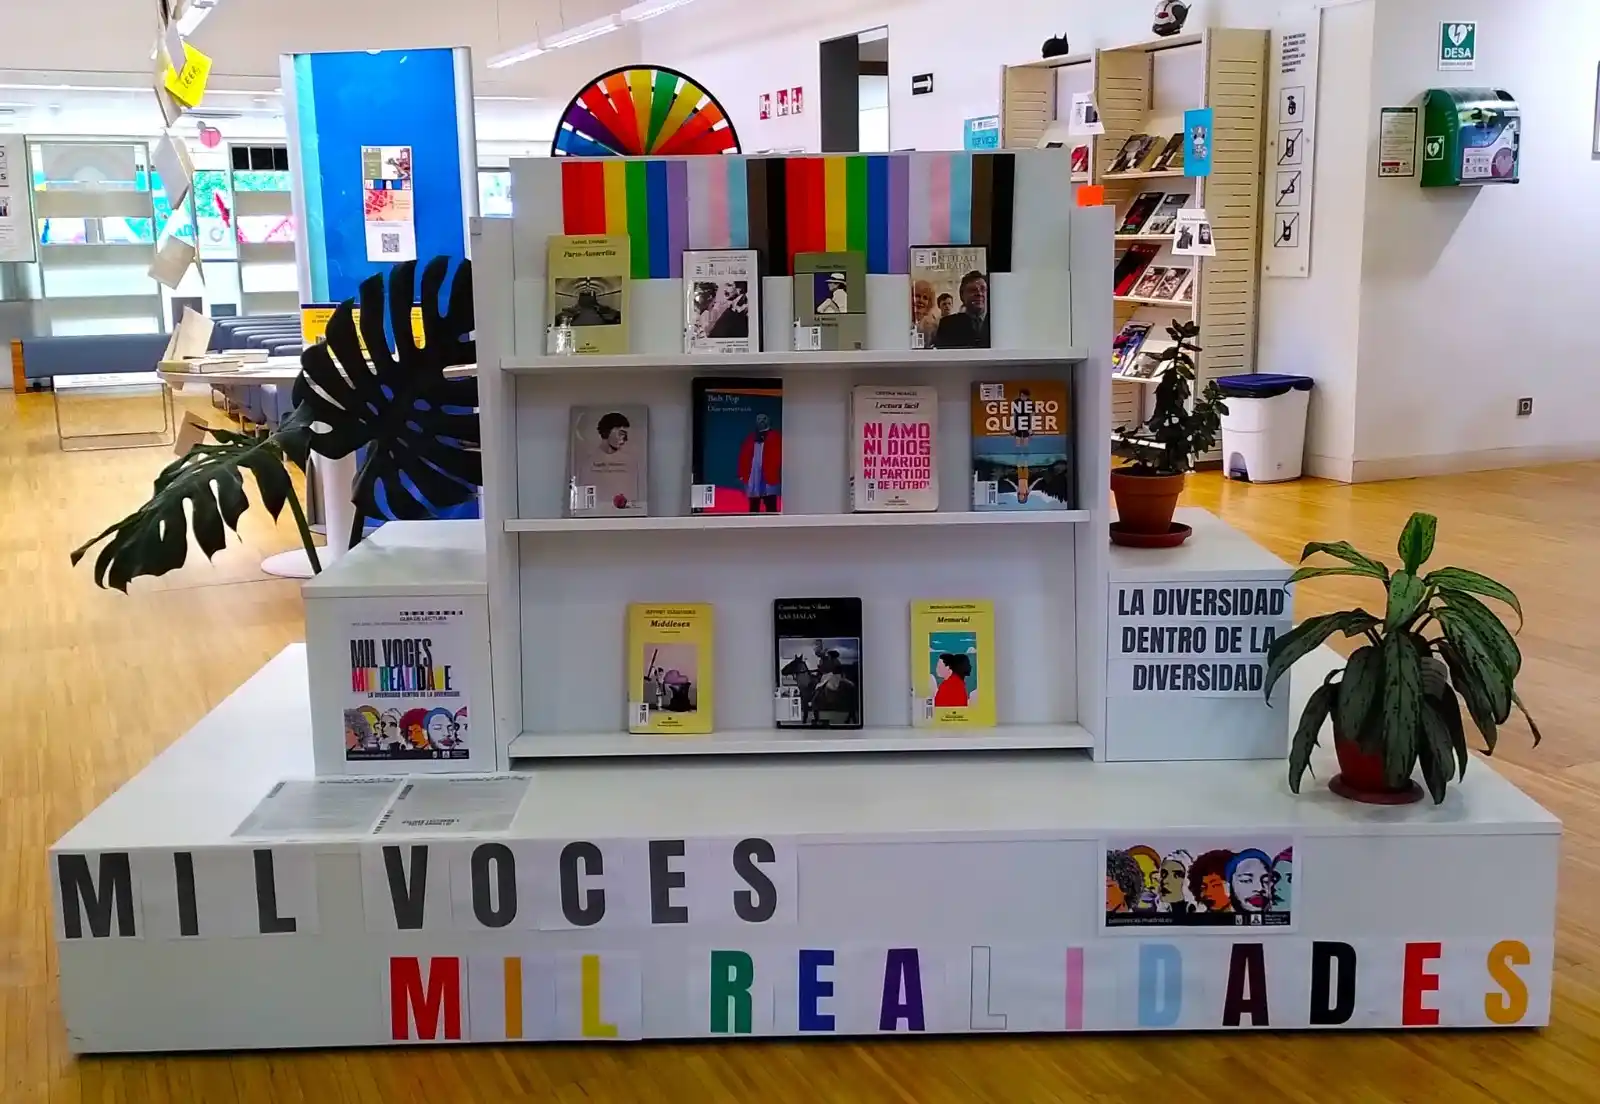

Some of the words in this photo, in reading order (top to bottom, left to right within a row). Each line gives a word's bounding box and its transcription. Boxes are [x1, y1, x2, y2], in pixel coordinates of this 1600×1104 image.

[1444, 47, 1472, 58] DESA
[875, 401, 902, 409] Lectura
[864, 423, 883, 438] NI
[888, 423, 930, 438] AMO
[986, 416, 1059, 431] QUEER
[864, 440, 882, 455] NI
[888, 440, 931, 455] DIOS
[864, 457, 876, 467] NI
[881, 457, 930, 467] MARIDO
[864, 469, 875, 479] NI
[880, 469, 930, 479] PARTIDO
[878, 481, 890, 489] DE
[1118, 589, 1145, 616] LA
[1153, 589, 1284, 616] DIVERSIDAD
[650, 620, 690, 628] Middlesex
[1122, 626, 1207, 653] DENTRO
[1215, 626, 1243, 653] DE
[1250, 626, 1276, 653] LA
[350, 639, 378, 668] MIL
[382, 638, 433, 668] VOCES
[1132, 664, 1263, 691] DIVERSIDAD
[57, 849, 296, 939] MIL
[382, 838, 778, 930] VOCES
[389, 954, 619, 1040] MIL
[709, 940, 1531, 1034] REALIDADES
